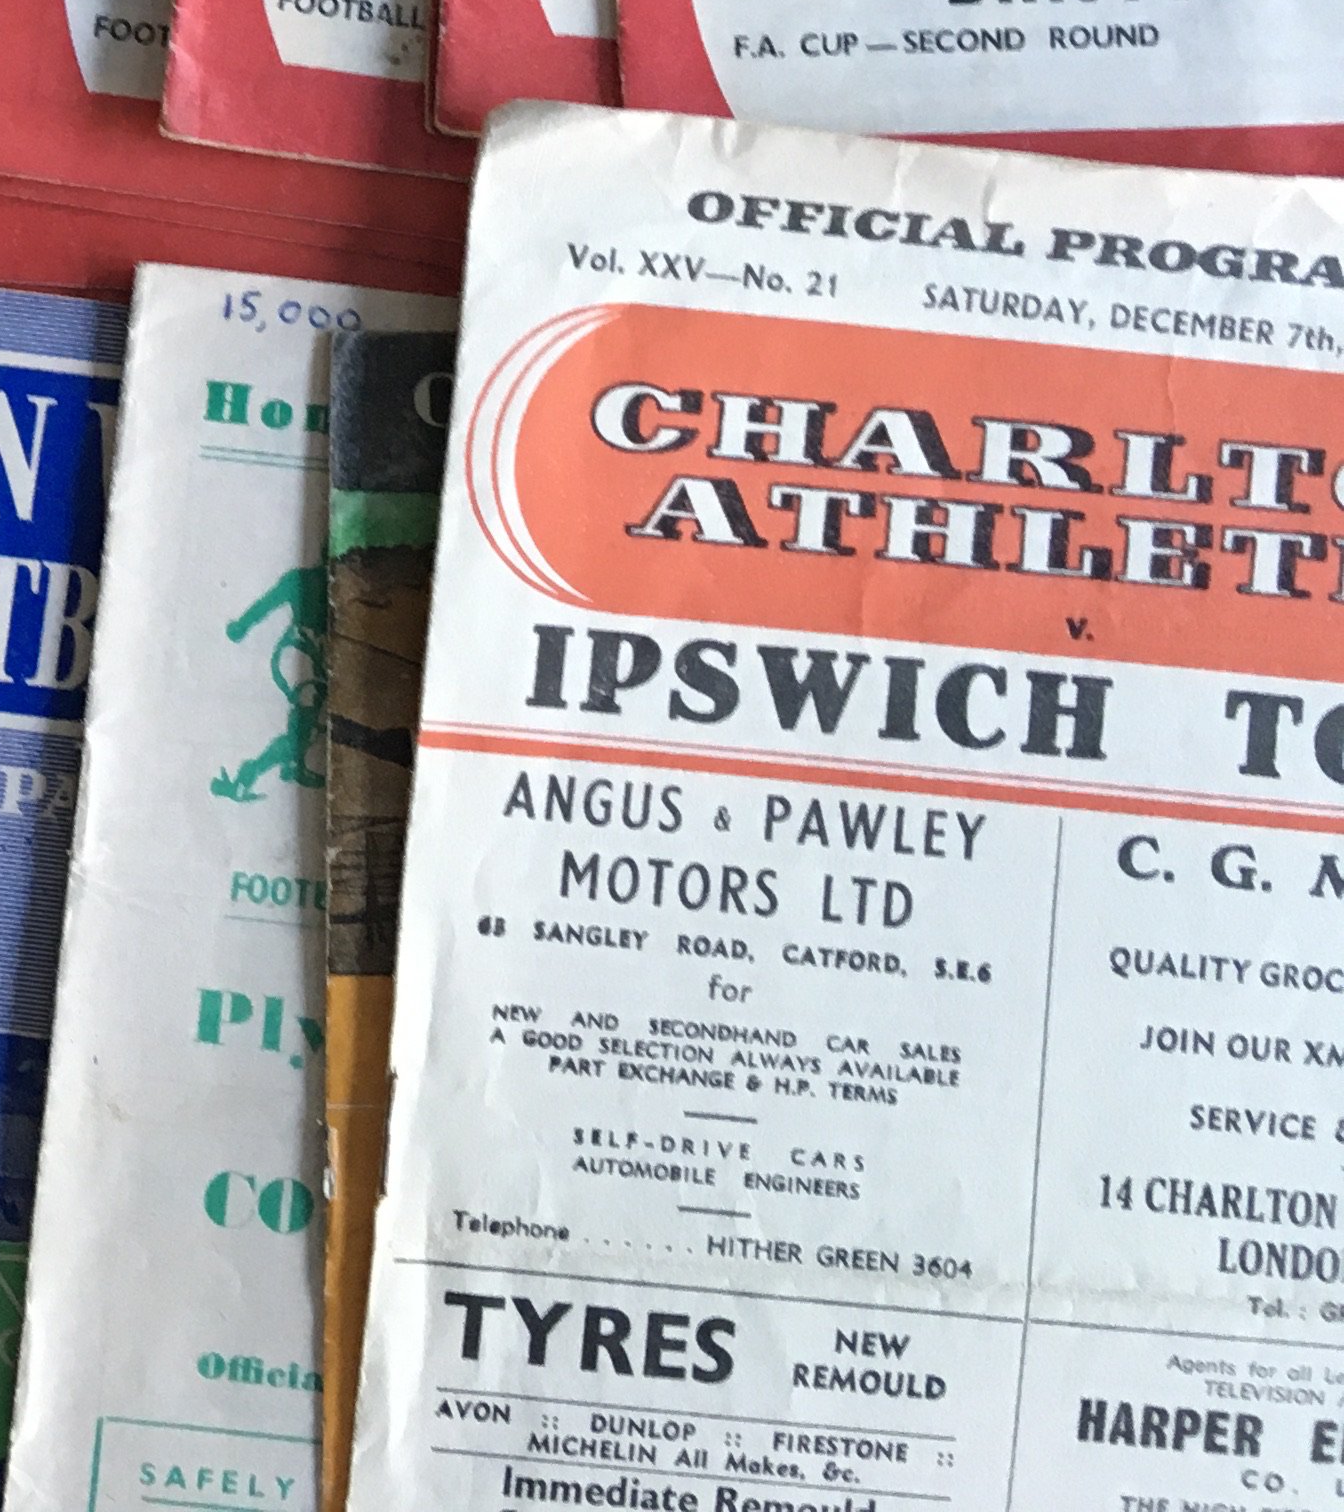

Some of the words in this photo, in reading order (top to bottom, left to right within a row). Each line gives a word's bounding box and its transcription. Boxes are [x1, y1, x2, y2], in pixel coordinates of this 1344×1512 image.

[733, 34, 786, 60] F.A.
[1049, 23, 1161, 50] ROUND
[686, 189, 1027, 257] OFFICIAL
[567, 241, 626, 275] Vol.
[805, 269, 839, 299] 21
[221, 289, 362, 333] 15,000
[921, 283, 1096, 331] SATURDAY,
[1110, 302, 1275, 346] DECEMBER
[524, 623, 1115, 765] IPSWICH
[502, 770, 684, 834] ANGUS
[713, 805, 732, 833] &
[763, 794, 987, 861] PAWLEY
[558, 848, 780, 919] MOTORS
[821, 874, 914, 929] LTD
[1116, 834, 1176, 884] C.
[1211, 842, 1272, 893] G.
[532, 919, 649, 952] SANGLEY
[933, 956, 993, 985] S.E.6
[1109, 946, 1252, 984] QUALITY
[707, 973, 753, 1005] for
[488, 1027, 506, 1046] A
[521, 1029, 583, 1053] GOOD
[597, 1038, 714, 1065] SELECTION
[729, 1050, 822, 1075] ALWAYS
[837, 1058, 961, 1088] AVAILABLE
[491, 1003, 543, 1024] NEW
[570, 1009, 619, 1032] AND
[647, 1017, 798, 1050] SECONDHAND
[826, 1034, 870, 1056] CAR
[898, 1041, 962, 1064] SALES
[1138, 1024, 1216, 1058] JOIN
[1226, 1032, 1292, 1065] OUR
[548, 1054, 605, 1077] PART
[616, 1062, 736, 1090] EXCHANGE
[745, 1075, 763, 1093] &
[828, 1082, 898, 1106] TERMS
[1189, 1102, 1317, 1141] SERVICE
[571, 1155, 716, 1187] AUTOMOBILE
[744, 1172, 861, 1201] ENGINEERS
[789, 1147, 865, 1173] CARS
[1098, 1173, 1134, 1211] 14
[1144, 1175, 1338, 1229] CHARLTON
[452, 1207, 571, 1243] Telephone
[706, 1233, 803, 1264] HITHER
[816, 1242, 900, 1274] GREEN
[911, 1254, 973, 1280] 3604
[444, 1290, 736, 1385] TYRES
[834, 1327, 911, 1359] NEW
[792, 1362, 948, 1401] REMOULD
[1166, 1353, 1237, 1377] Agents
[1248, 1360, 1278, 1379] for
[1203, 1378, 1326, 1406] TELEVISION
[434, 1398, 512, 1425] AVON
[590, 1412, 697, 1441] DUNLOP
[772, 1430, 909, 1463] FIRESTONE
[526, 1432, 657, 1465] MICHELIN
[674, 1447, 709, 1469] All
[1075, 1395, 1264, 1458] HARPER
[139, 1460, 296, 1501] SAFELY
[502, 1464, 699, 1512] Immediate
